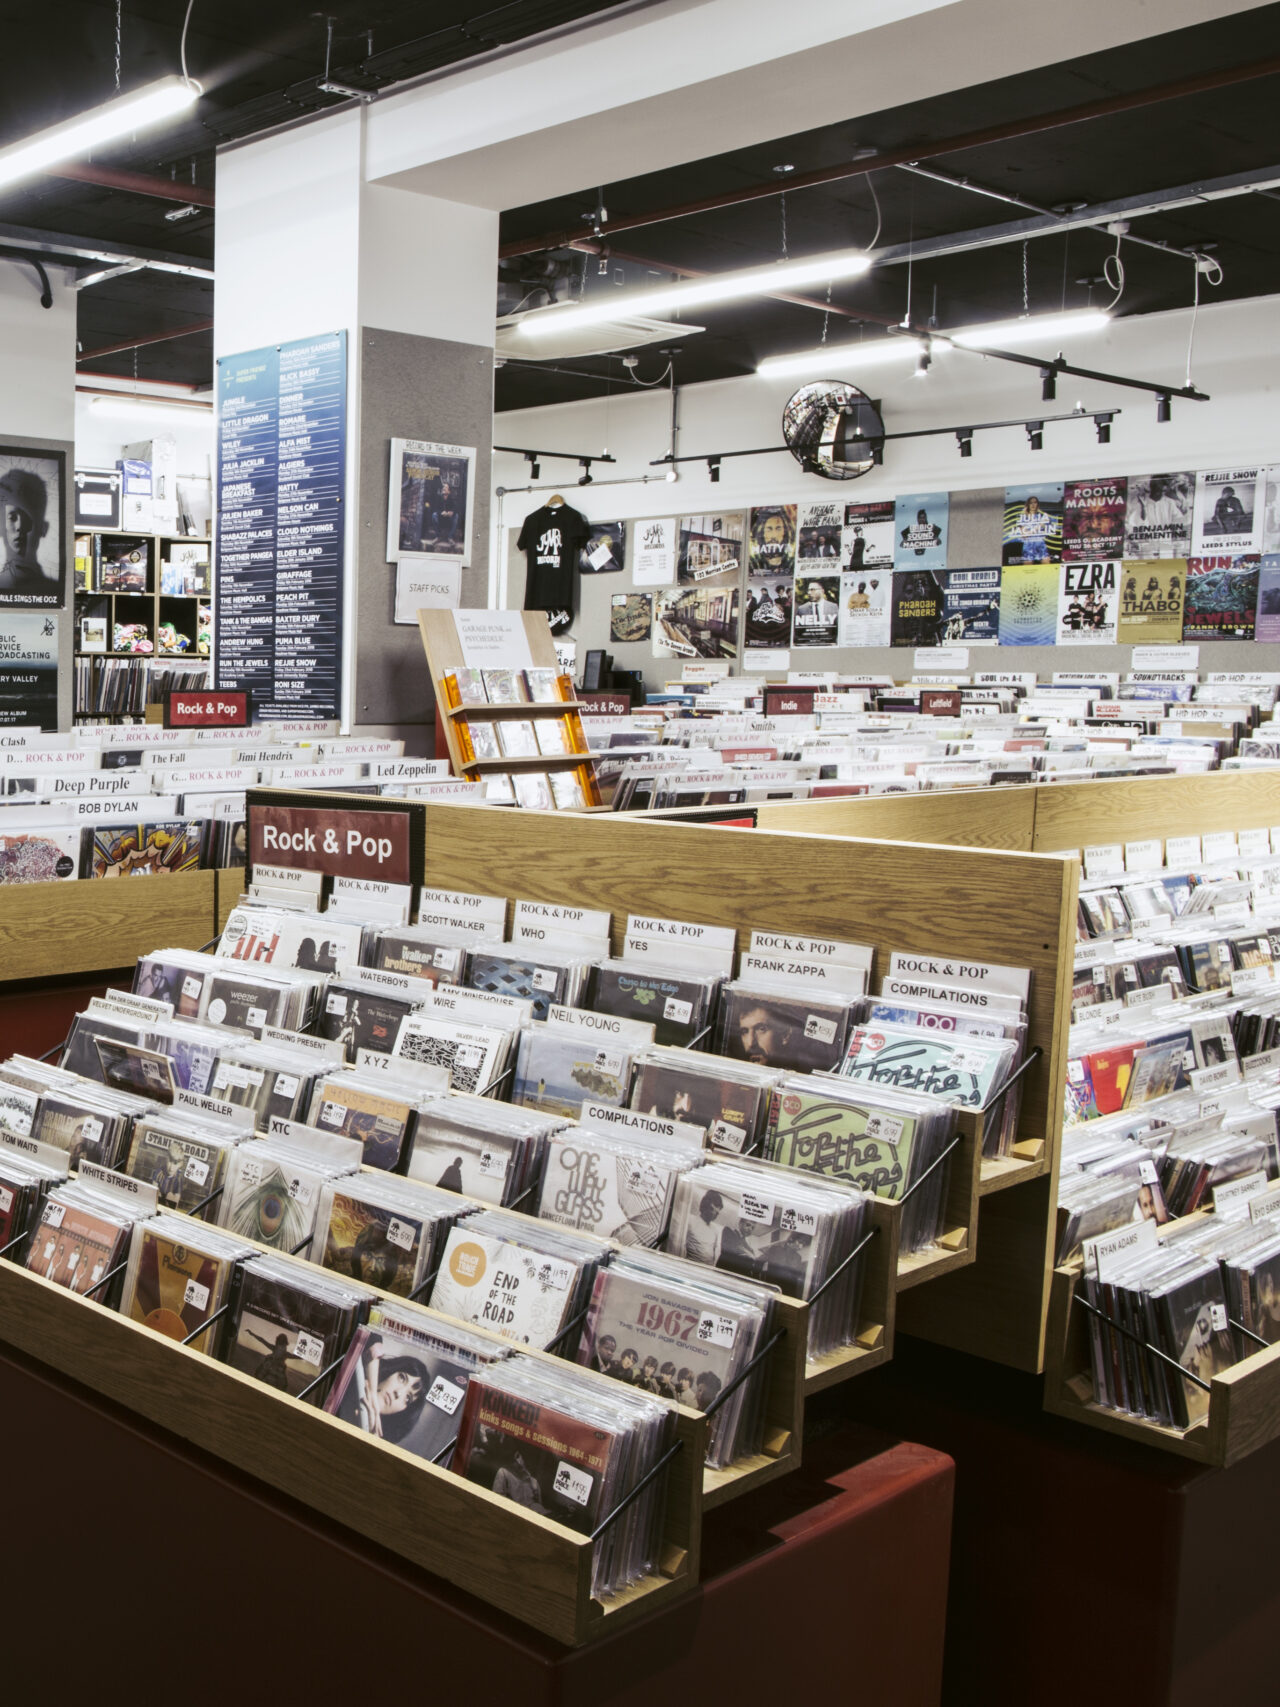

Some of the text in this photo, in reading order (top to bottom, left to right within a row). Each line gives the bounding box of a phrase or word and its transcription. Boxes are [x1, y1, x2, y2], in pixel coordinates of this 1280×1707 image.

[223, 414, 268, 427] LITTLE DRAGON
[435, 445, 445, 453] THE
[1205, 470, 1258, 482] REJJIE SNOW
[1074, 486, 1117, 497] ROOTS
[1065, 496, 1124, 508] MANUVA
[1018, 514, 1050, 523] JULIA
[277, 524, 333, 536] CLOUD NOTHINGS
[1009, 524, 1056, 536] JACKLIN
[1133, 523, 1183, 533] BENJAMIN
[1129, 530, 1187, 540] CLEMENTINE
[903, 540, 938, 548] MACHINE
[277, 547, 322, 557] ELDER ISLAND
[1188, 557, 1232, 575] RUN
[1065, 563, 1115, 590] EZRA
[409, 583, 449, 594] STAFF PICKS
[1123, 600, 1180, 612] THABO
[796, 614, 836, 625] NELLY
[1185, 610, 1255, 624] JEWELS
[245, 659, 268, 667] JEWELS
[12, 675, 38, 683] VALLEY
[1133, 673, 1185, 681] SOUNDTRACKS
[178, 702, 237, 716] Rock & Pop
[781, 701, 797, 710] Indie
[749, 721, 776, 731] Smiths
[2, 737, 26, 746] Clash
[152, 753, 185, 763] The Fall
[237, 750, 293, 762] Jimi Hendrix
[377, 763, 437, 778] Led Zeppelin
[55, 777, 130, 794] Deep Purple
[79, 802, 138, 813] BOB DYLAN
[263, 825, 392, 863] Rock & Pop
[422, 914, 484, 932] SCOTT WALKER
[521, 928, 545, 940] WHO
[629, 940, 648, 951] YES
[756, 935, 836, 956] ROCK & POP
[747, 958, 825, 978] FRANK ZAPPA
[897, 958, 989, 979] ROCK & POP
[360, 970, 408, 988] WATERBOYS
[231, 990, 258, 1003] weezer
[891, 983, 988, 1006] COMPILATIONS
[434, 997, 456, 1010] WIRE
[550, 1008, 620, 1033] NEIL YOUNG
[918, 1013, 955, 1031] 100
[267, 1029, 326, 1050] WEDDING PRESENT
[179, 1093, 233, 1116] PAUL WELLER
[589, 1107, 674, 1136] COMPILATIONS
[272, 1122, 290, 1136] XTC
[2, 1132, 38, 1154] TOM WAITS
[82, 1166, 138, 1193] WHITE STRIPES
[1100, 1233, 1138, 1257] RYAN ADAMS
[493, 1270, 520, 1290] END
[489, 1290, 516, 1306] OF THE
[483, 1301, 514, 1324] ROAD
[636, 1300, 699, 1341] 1967
[479, 1408, 499, 1425] kinks
[501, 1417, 523, 1438] songs
[525, 1430, 532, 1440] &
[532, 1431, 567, 1455] sessions
